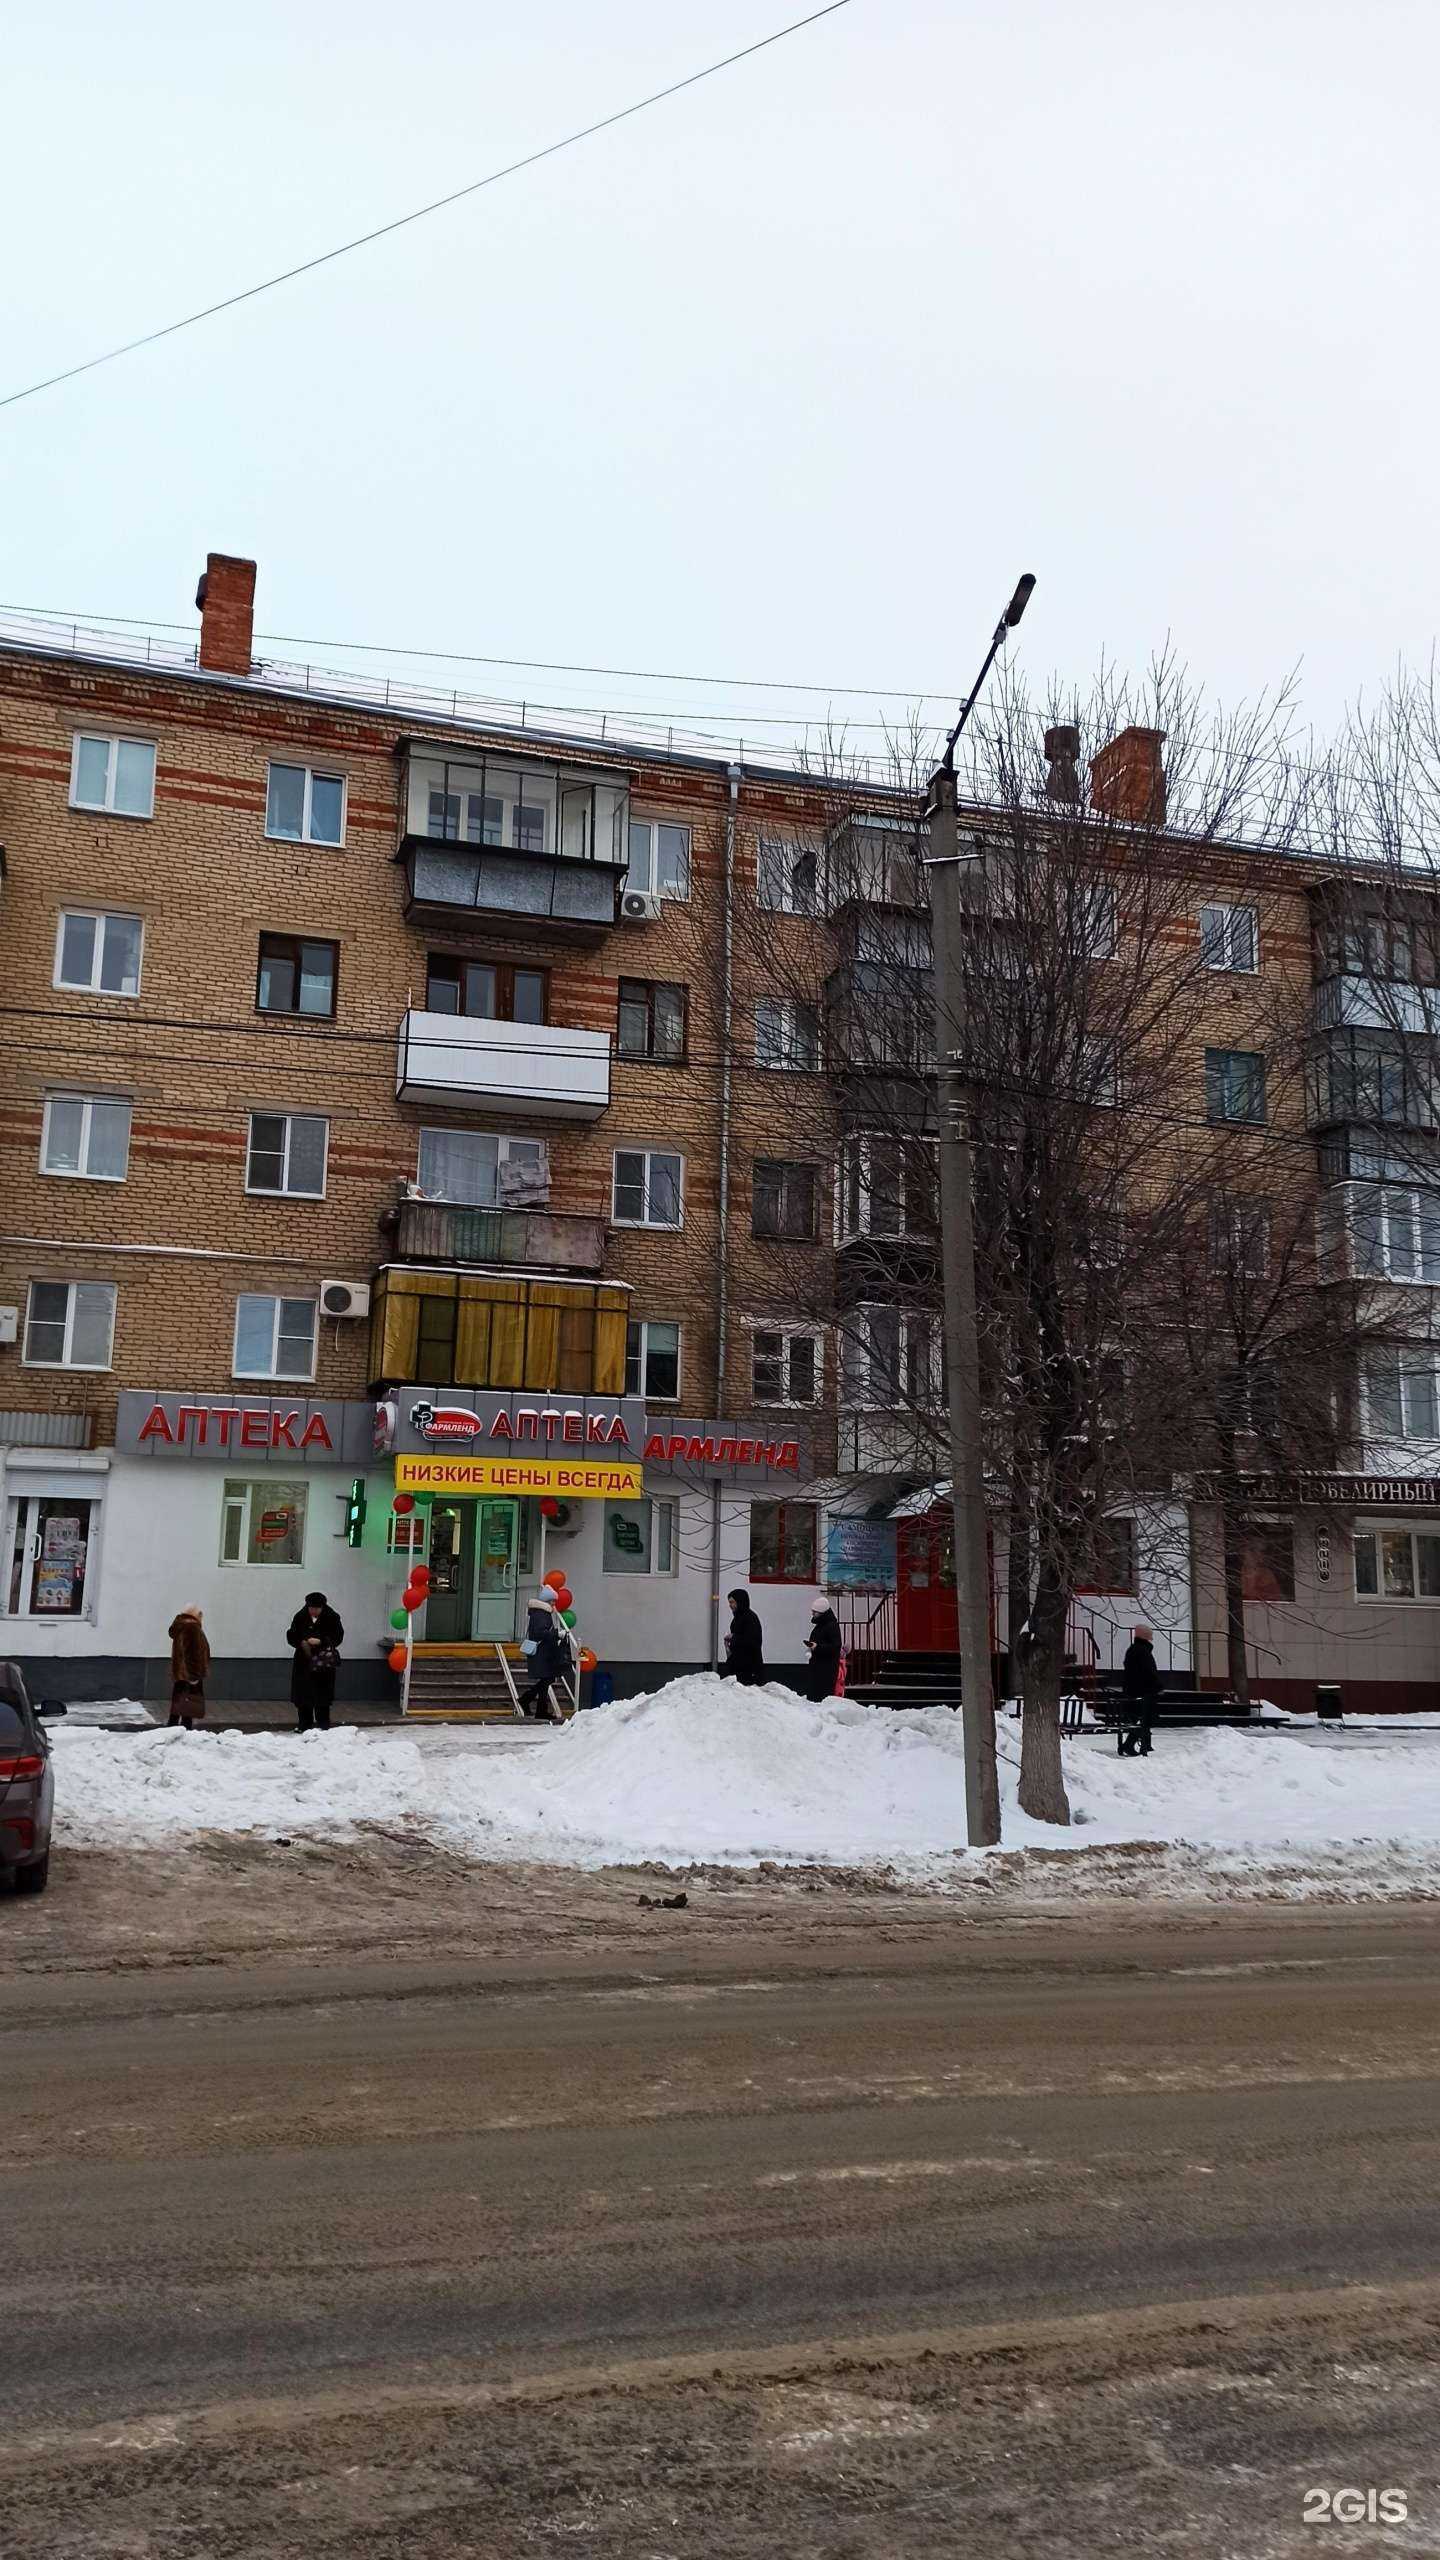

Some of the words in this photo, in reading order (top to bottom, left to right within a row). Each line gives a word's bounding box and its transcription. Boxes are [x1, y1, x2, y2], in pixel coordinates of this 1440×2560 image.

[138, 1404, 334, 1449] АПТЕКА
[425, 1422, 475, 1434] ФАРМЛЕНД
[489, 1408, 630, 1445] АПТЕКА
[643, 1434, 801, 1472] АРМЛЕНД
[402, 1464, 484, 1484] НИЗКИЕ
[491, 1467, 551, 1488] ЦЕНЫ
[558, 1470, 636, 1491] ВСЕГДА
